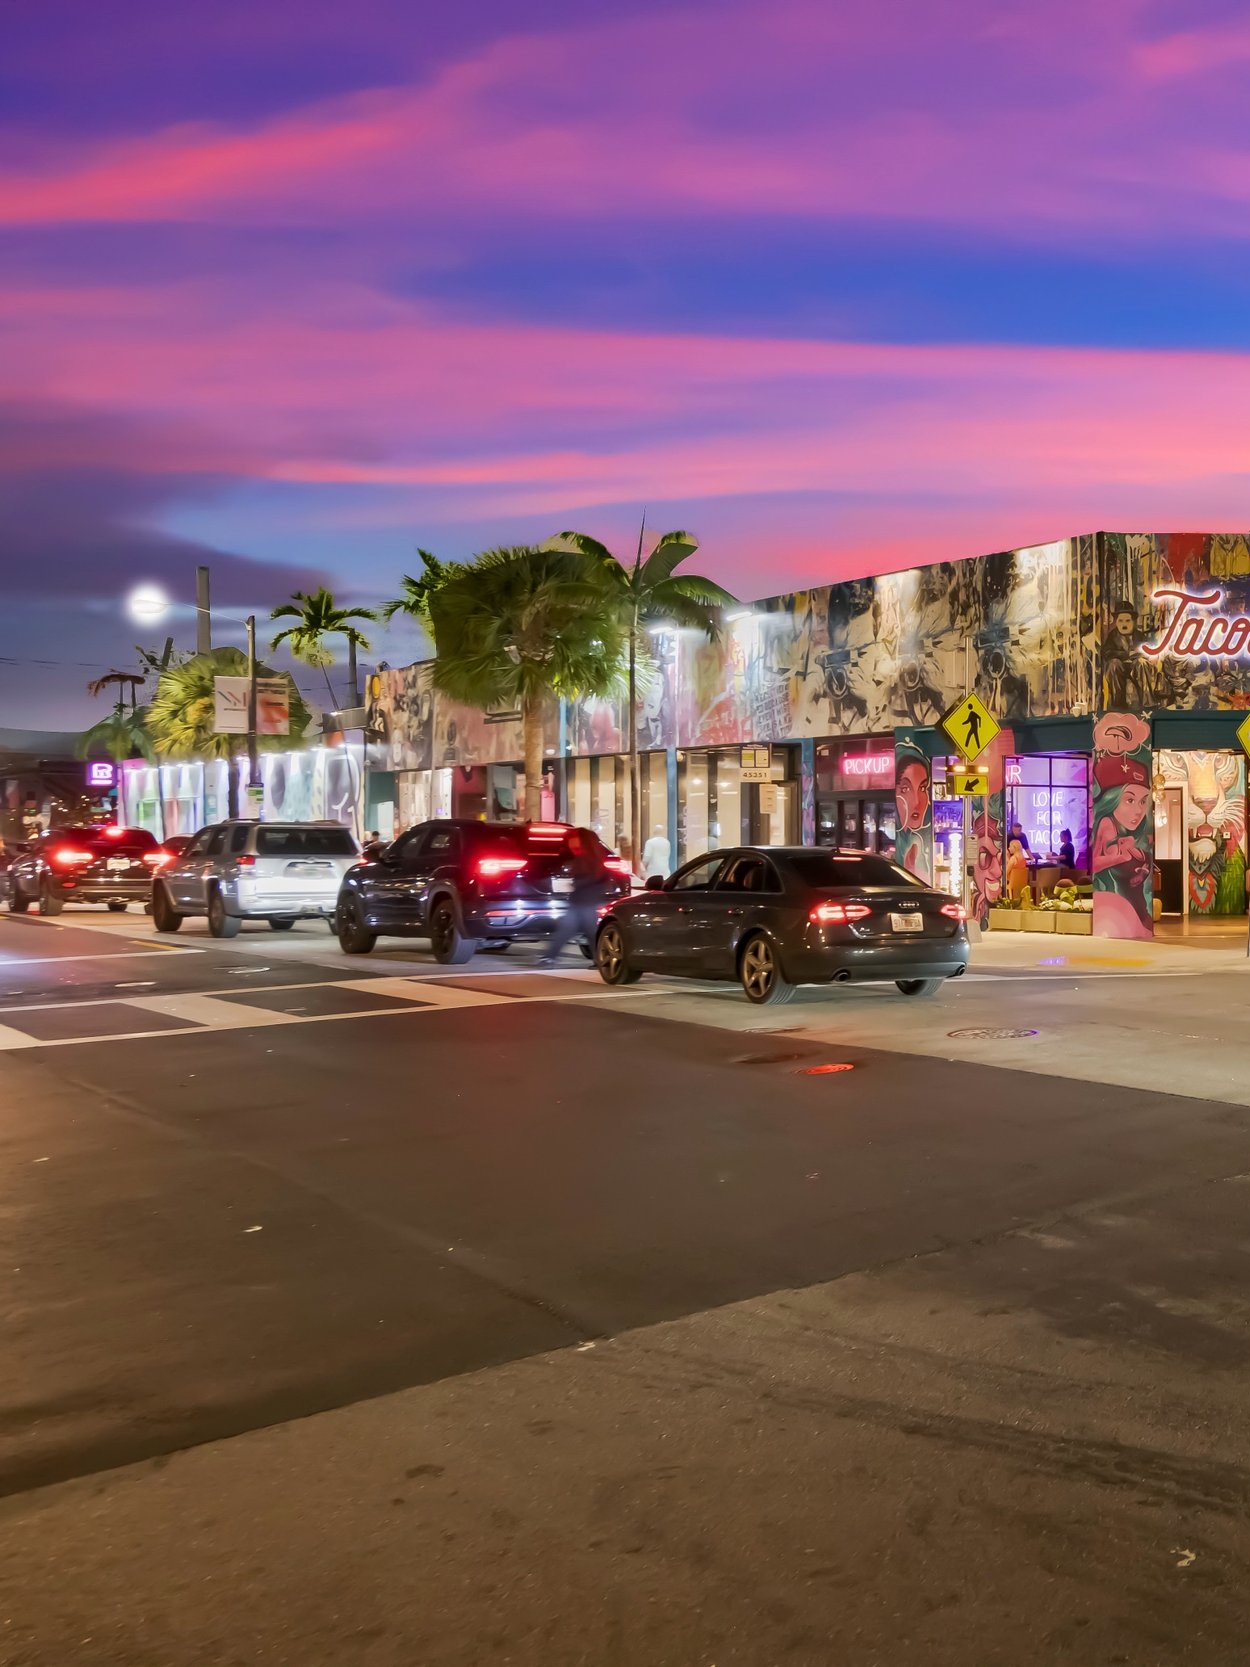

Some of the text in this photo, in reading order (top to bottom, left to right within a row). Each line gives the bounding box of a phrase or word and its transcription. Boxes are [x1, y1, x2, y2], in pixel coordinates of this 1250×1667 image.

[1033, 791, 1064, 807] LOVE
[1036, 810, 1062, 826] FOR
[1029, 829, 1061, 845] TACO
